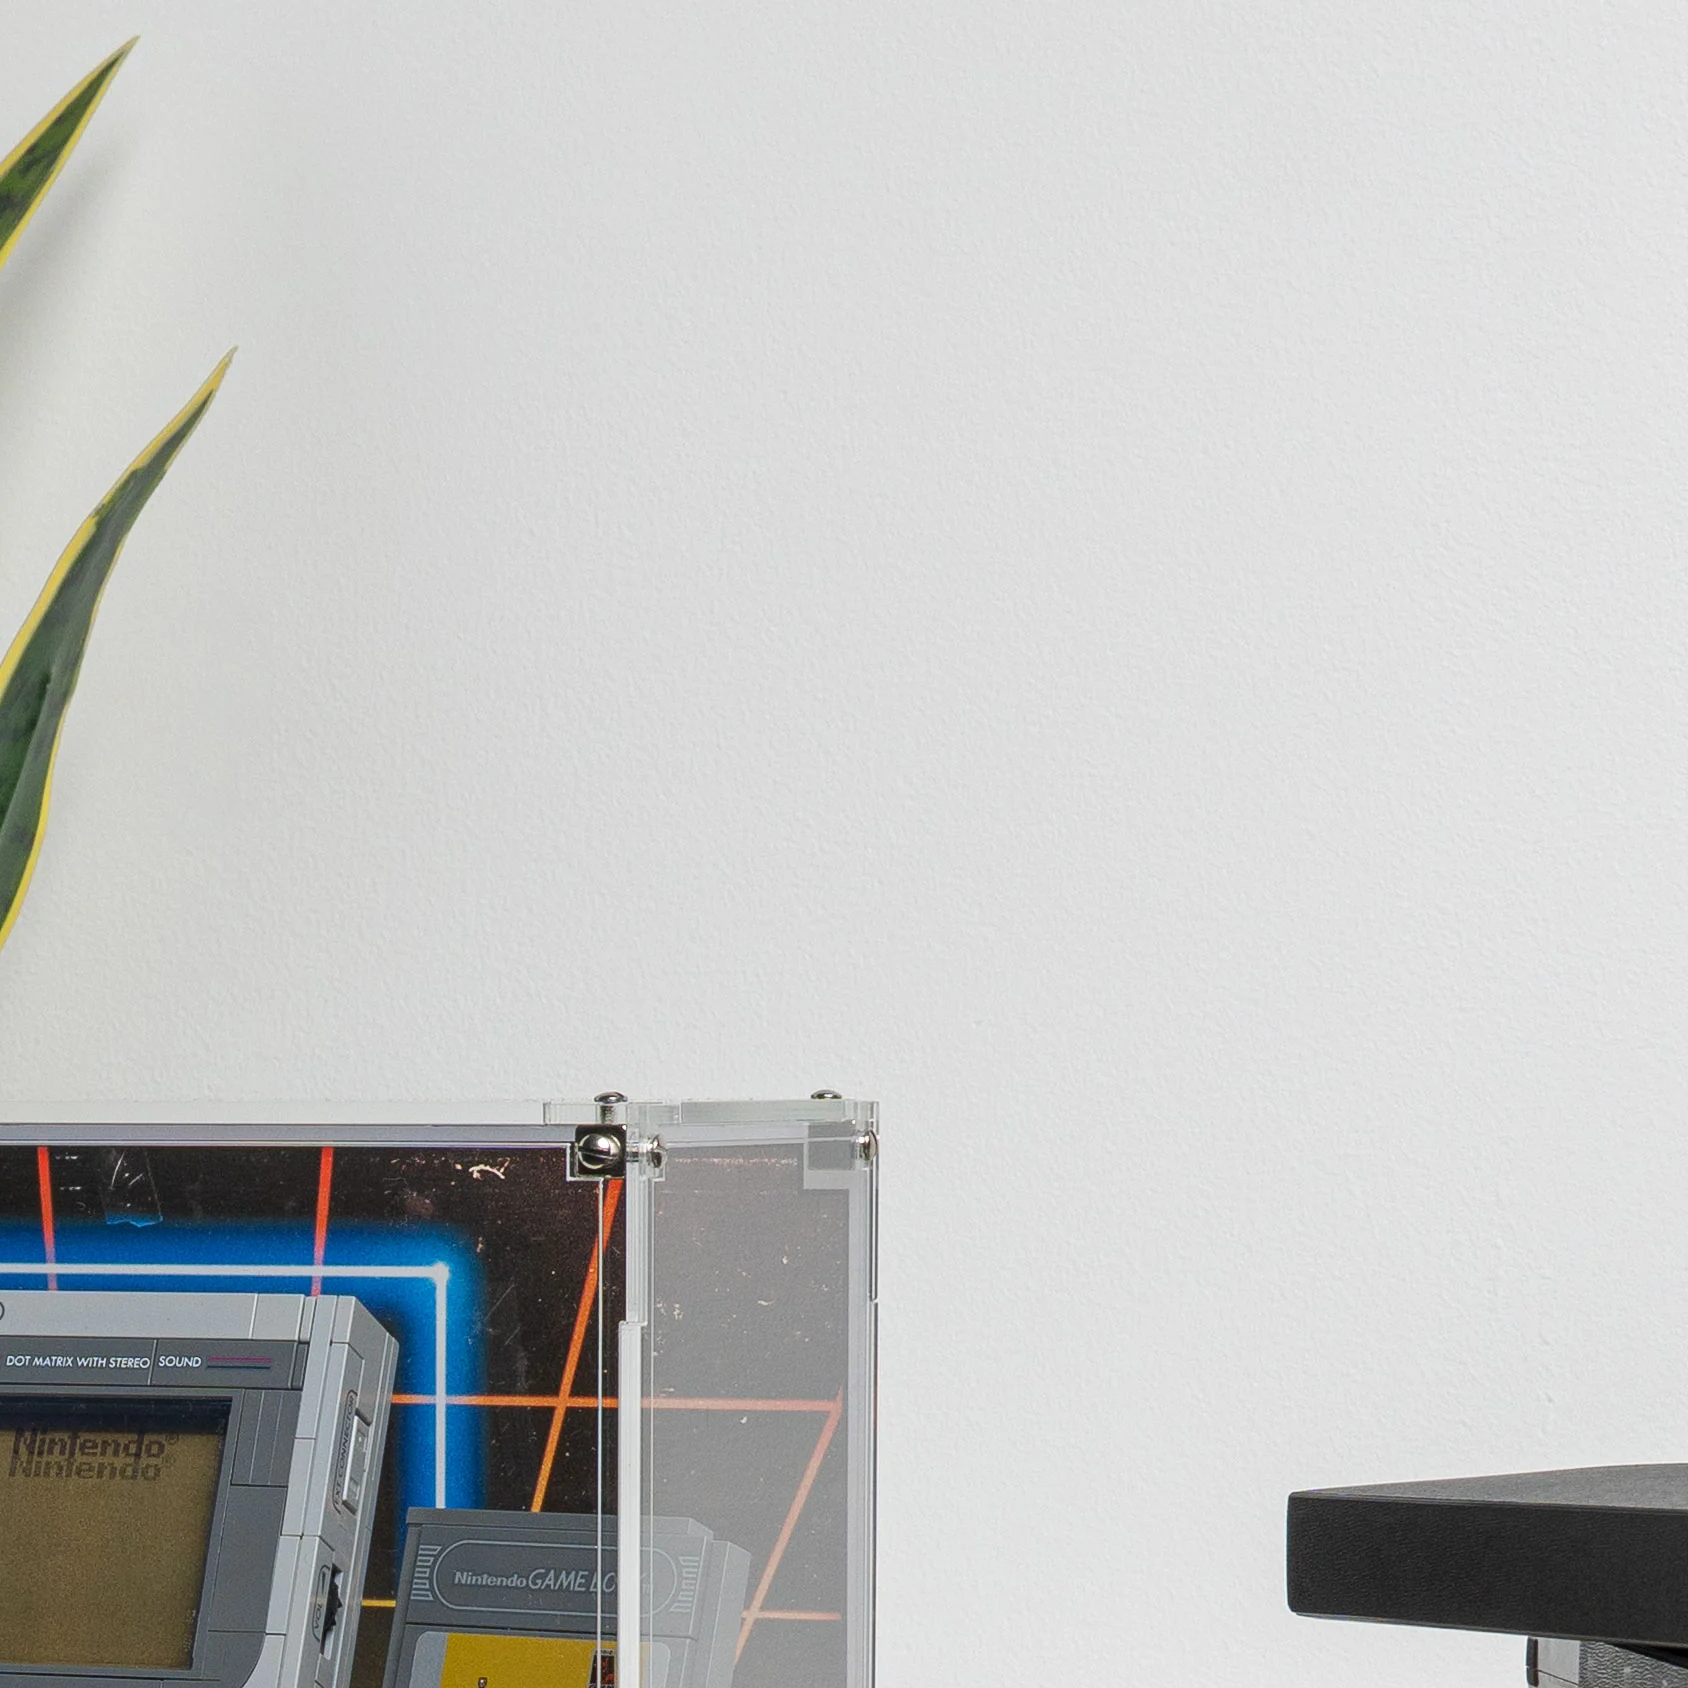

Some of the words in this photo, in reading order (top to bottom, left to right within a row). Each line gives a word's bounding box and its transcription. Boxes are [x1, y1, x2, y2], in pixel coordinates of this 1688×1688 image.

[6, 1354, 32, 1368] DOT
[32, 1355, 74, 1368] MATRIX
[76, 1356, 106, 1369] WITH
[108, 1357, 150, 1369] STEREO
[158, 1355, 202, 1368] SOUND
[454, 1570, 527, 1588] Nintendo
[528, 1568, 589, 1592] GAME
